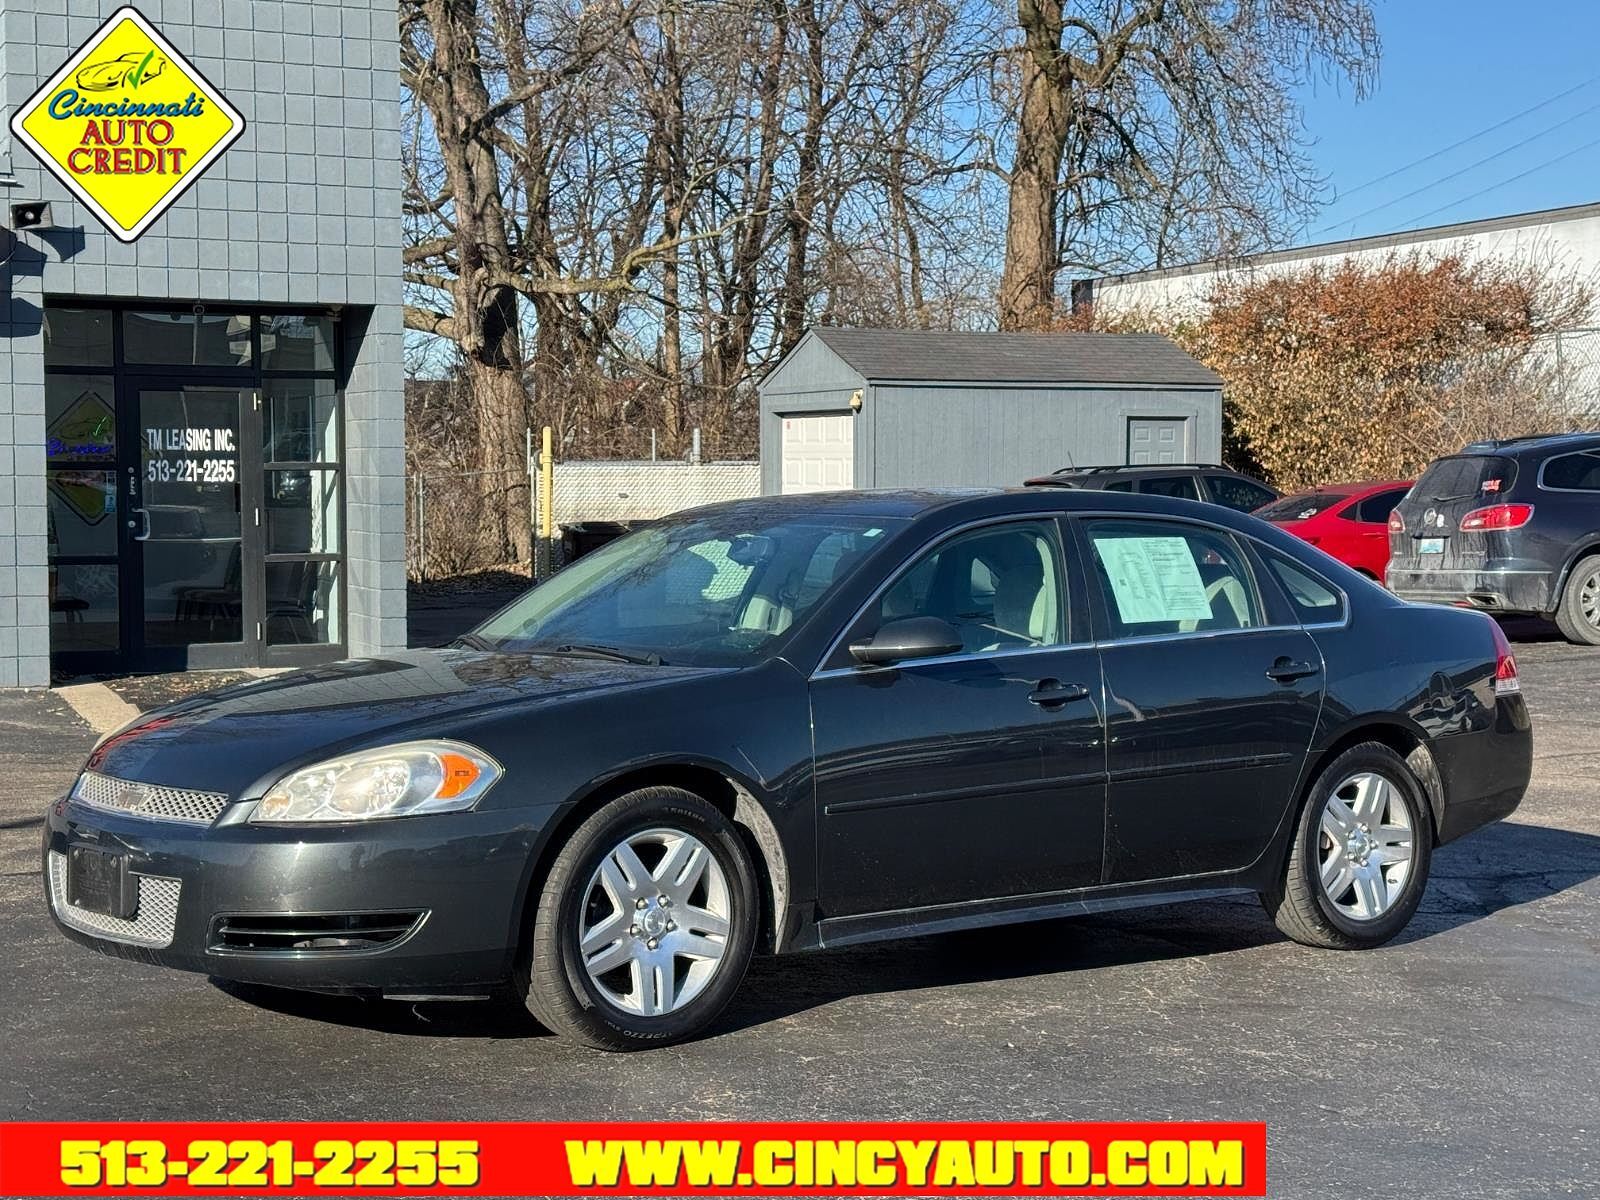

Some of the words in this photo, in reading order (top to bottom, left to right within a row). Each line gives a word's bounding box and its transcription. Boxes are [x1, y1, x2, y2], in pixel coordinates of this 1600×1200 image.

[146, 428, 162, 450] TM
[166, 428, 212, 451] LEASING
[214, 428, 236, 451] INC.
[148, 459, 235, 482] 513-221-2255
